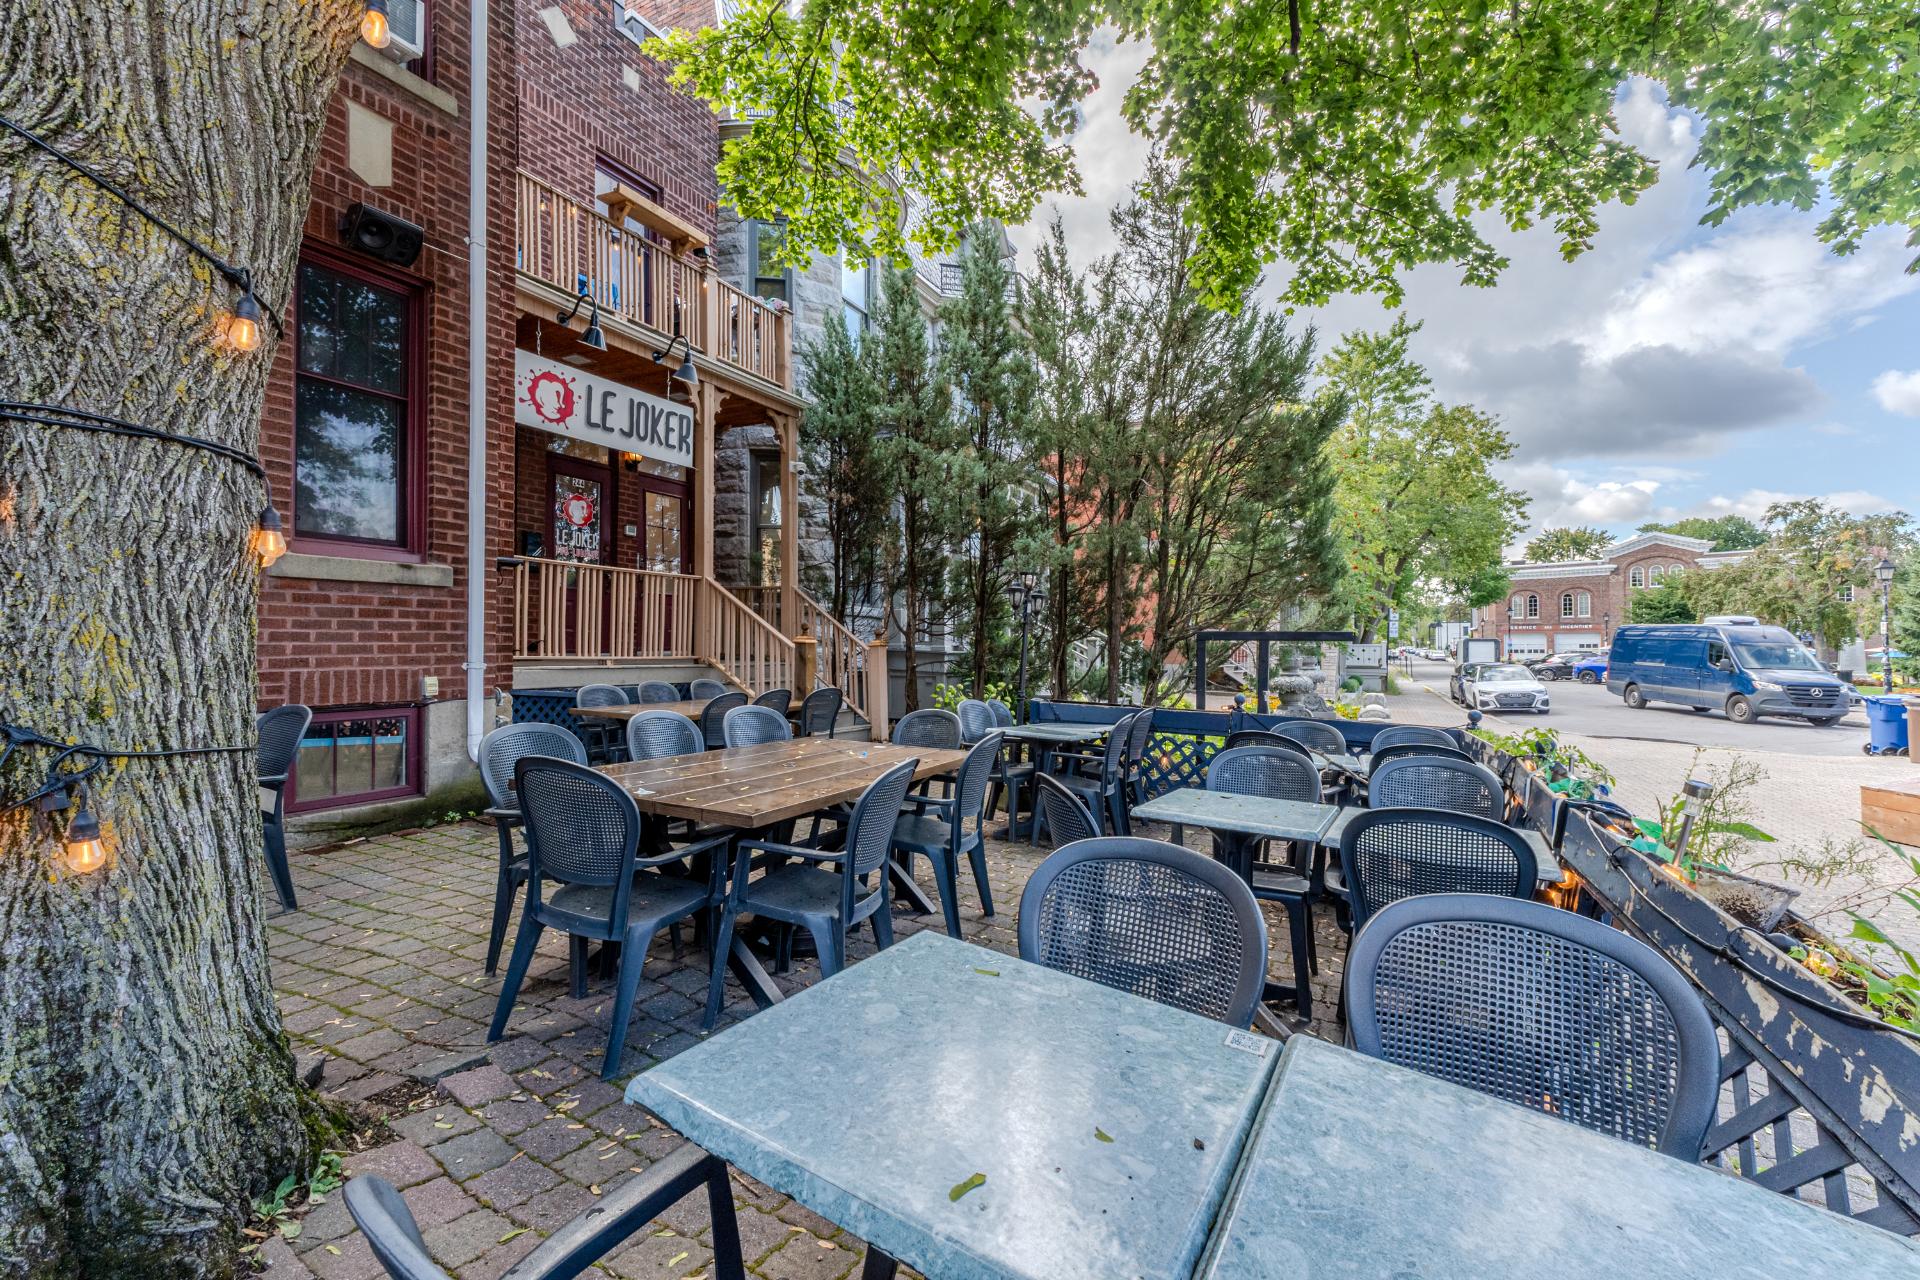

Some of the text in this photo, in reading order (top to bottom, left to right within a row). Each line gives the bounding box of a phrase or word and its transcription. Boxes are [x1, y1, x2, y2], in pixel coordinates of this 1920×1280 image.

[586, 385, 691, 454] LE JOKER
[556, 528, 599, 550] LE JOKER
